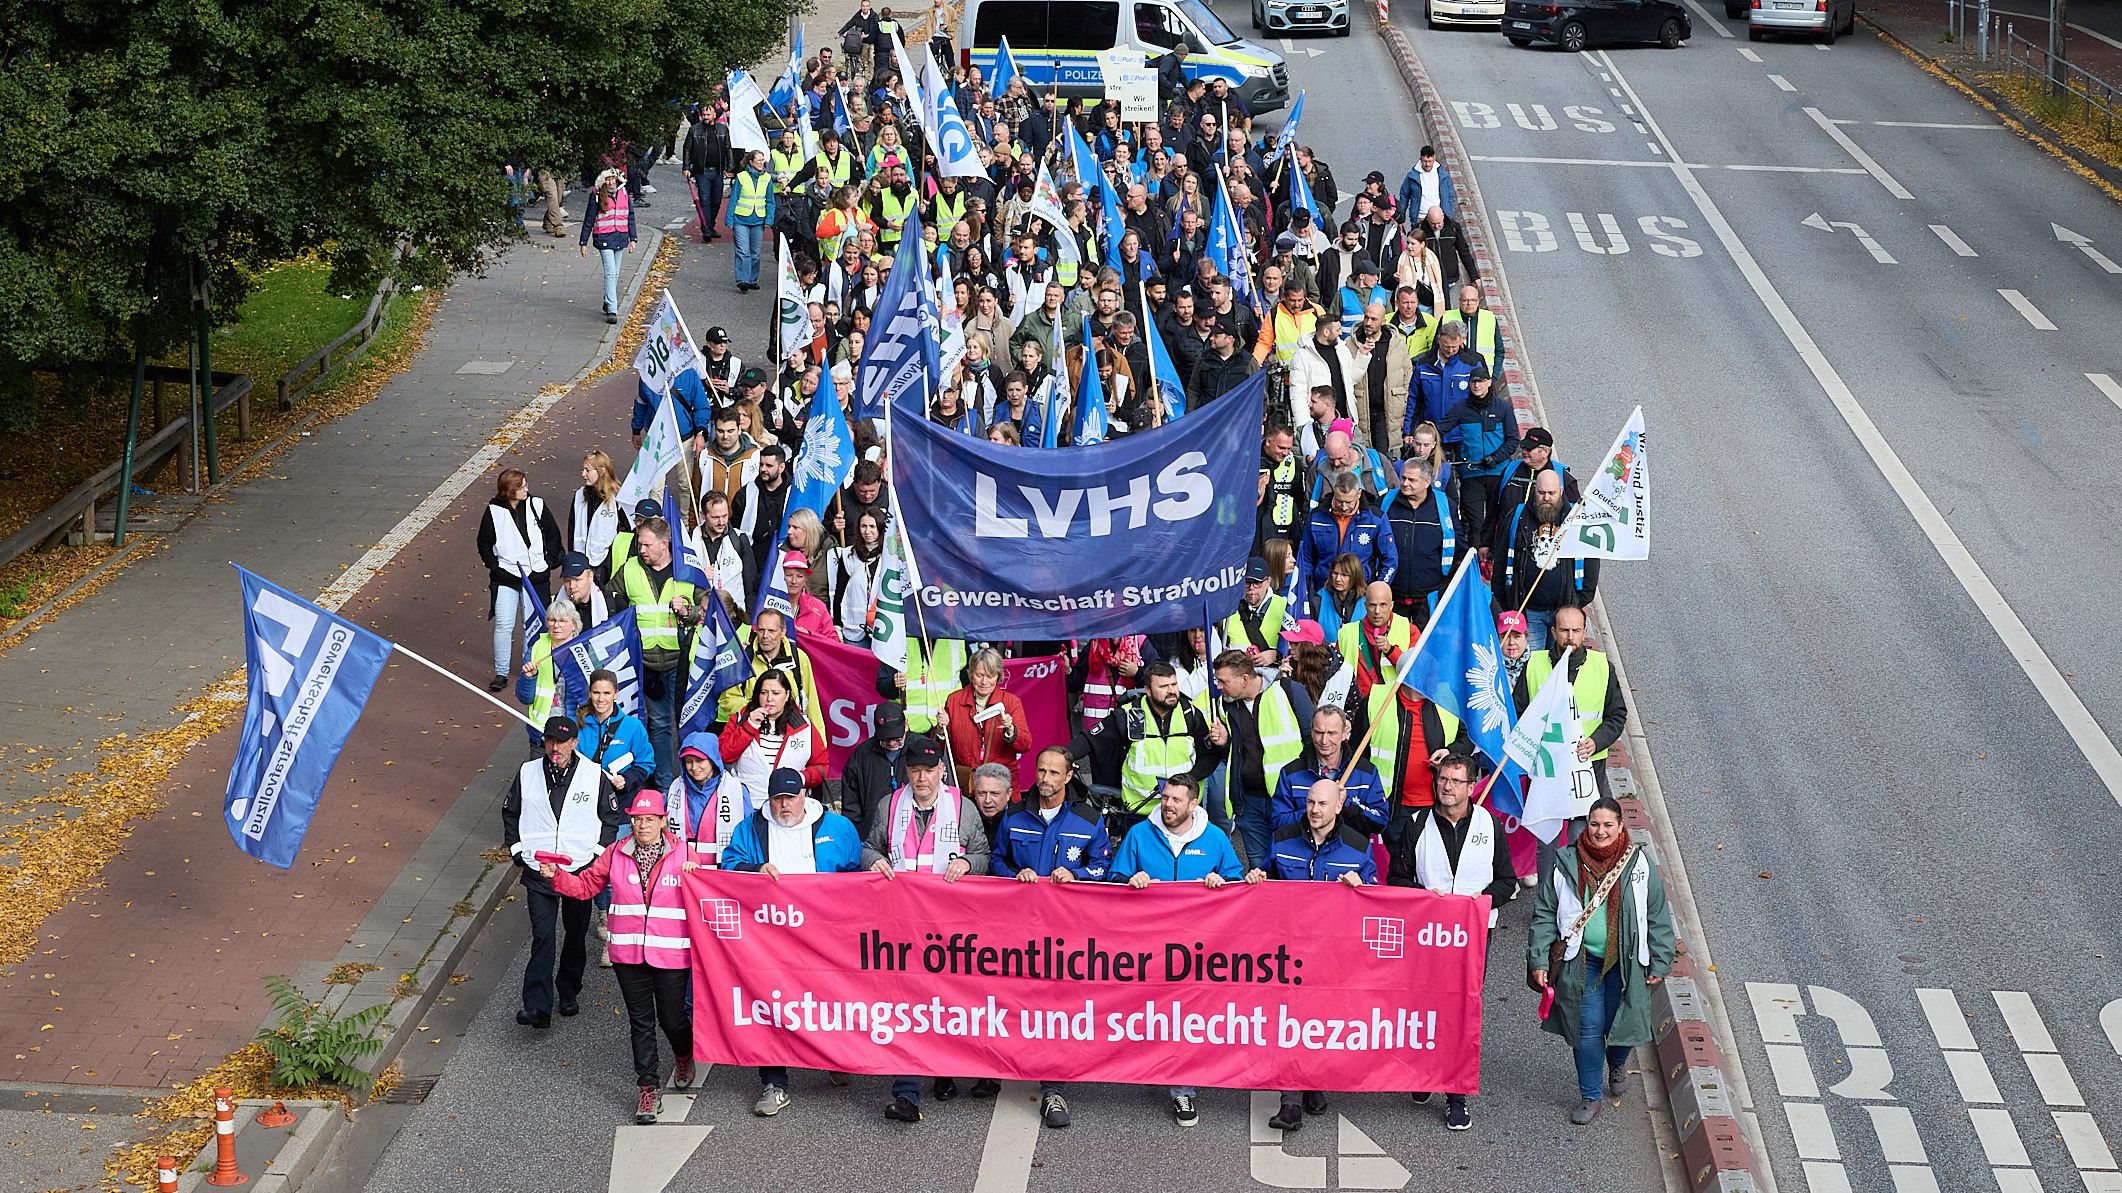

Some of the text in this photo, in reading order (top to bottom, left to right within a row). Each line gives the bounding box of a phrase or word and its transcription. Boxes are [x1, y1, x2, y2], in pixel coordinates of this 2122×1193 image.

[1065, 70, 1104, 80] POLIZE
[1451, 100, 1616, 134] BUS
[1496, 210, 1704, 258] BUS
[975, 451, 1214, 538] LVHS
[1592, 488, 1621, 514] Deutsch
[921, 562, 1247, 611] Gewerkschaft Strafvollz
[1327, 690, 1343, 703] DJG
[790, 738, 805, 750] DJG
[572, 791, 590, 804] DJG
[1471, 832, 1488, 846] DJG
[754, 904, 805, 928] dbb
[1417, 922, 1469, 948] dbb
[860, 930, 1303, 985] Ihr öffentlicher Dienst:
[732, 987, 1438, 1050] Leistungsstark und schlecht bezahlt!
